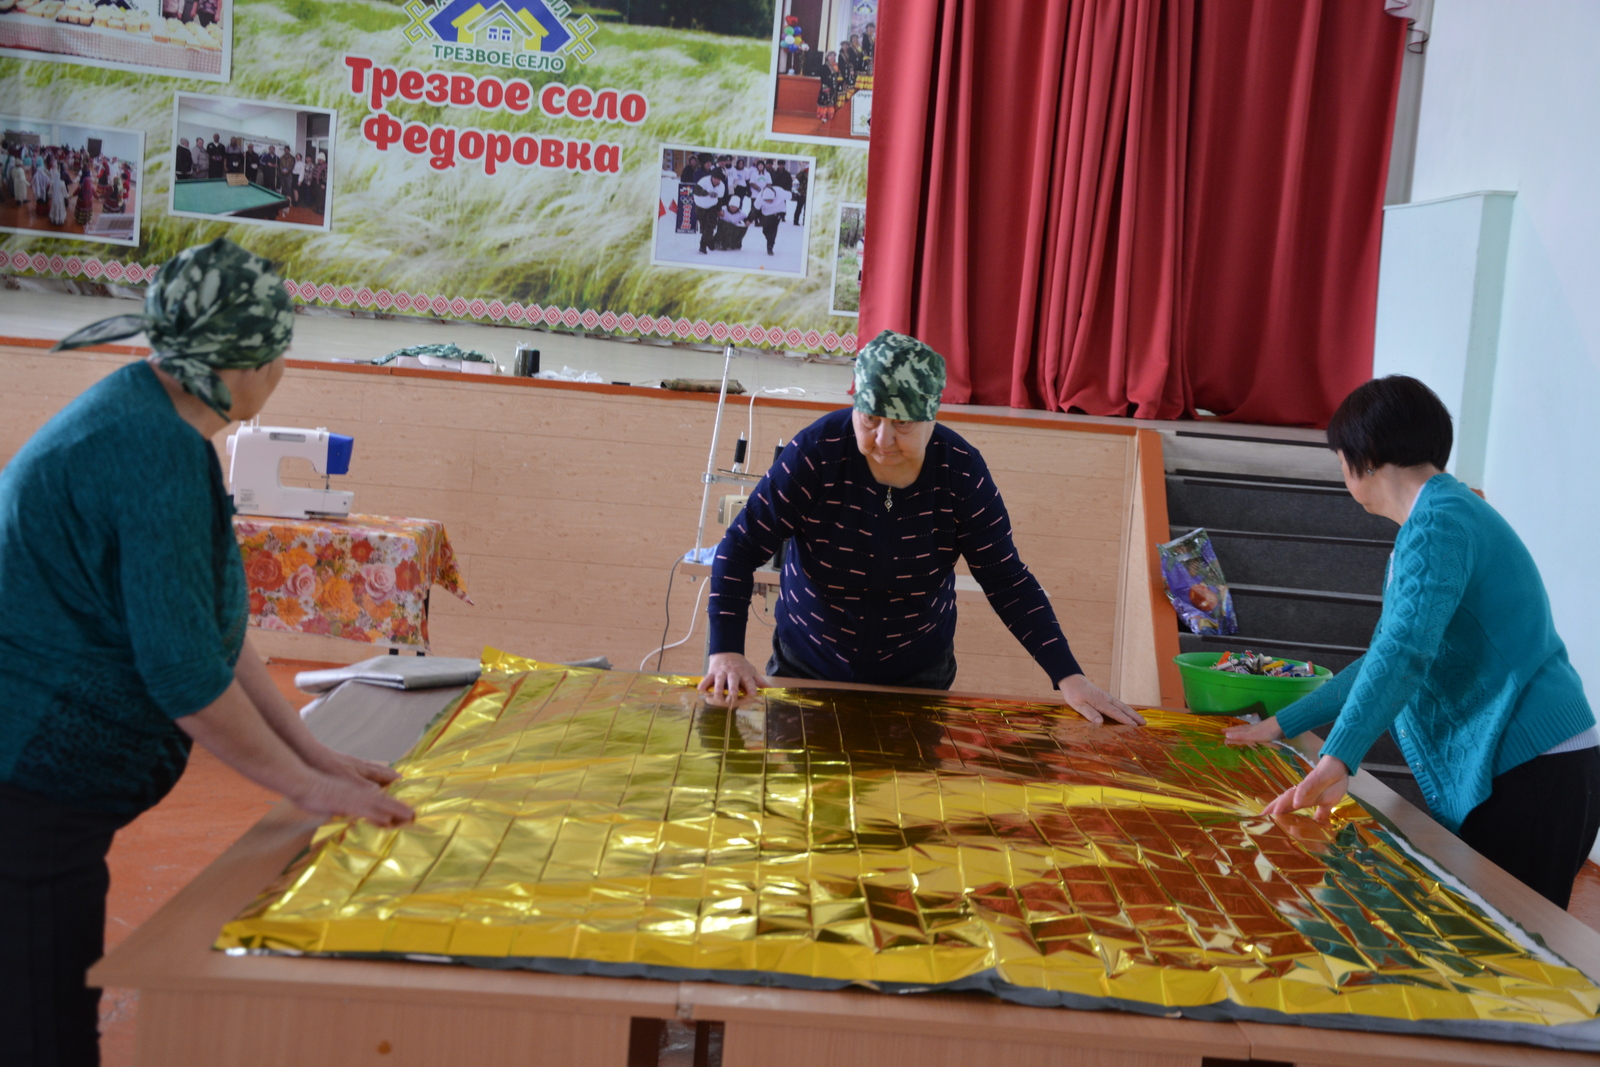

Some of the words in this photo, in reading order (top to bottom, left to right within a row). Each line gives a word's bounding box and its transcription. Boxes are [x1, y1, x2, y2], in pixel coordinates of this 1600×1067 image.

[432, 44, 511, 67] ТРЕЗВОЕ
[515, 54, 565, 71] СЕЛО
[345, 56, 531, 111] Трезвое
[541, 86, 647, 123] село
[363, 113, 620, 176] Федоровка
